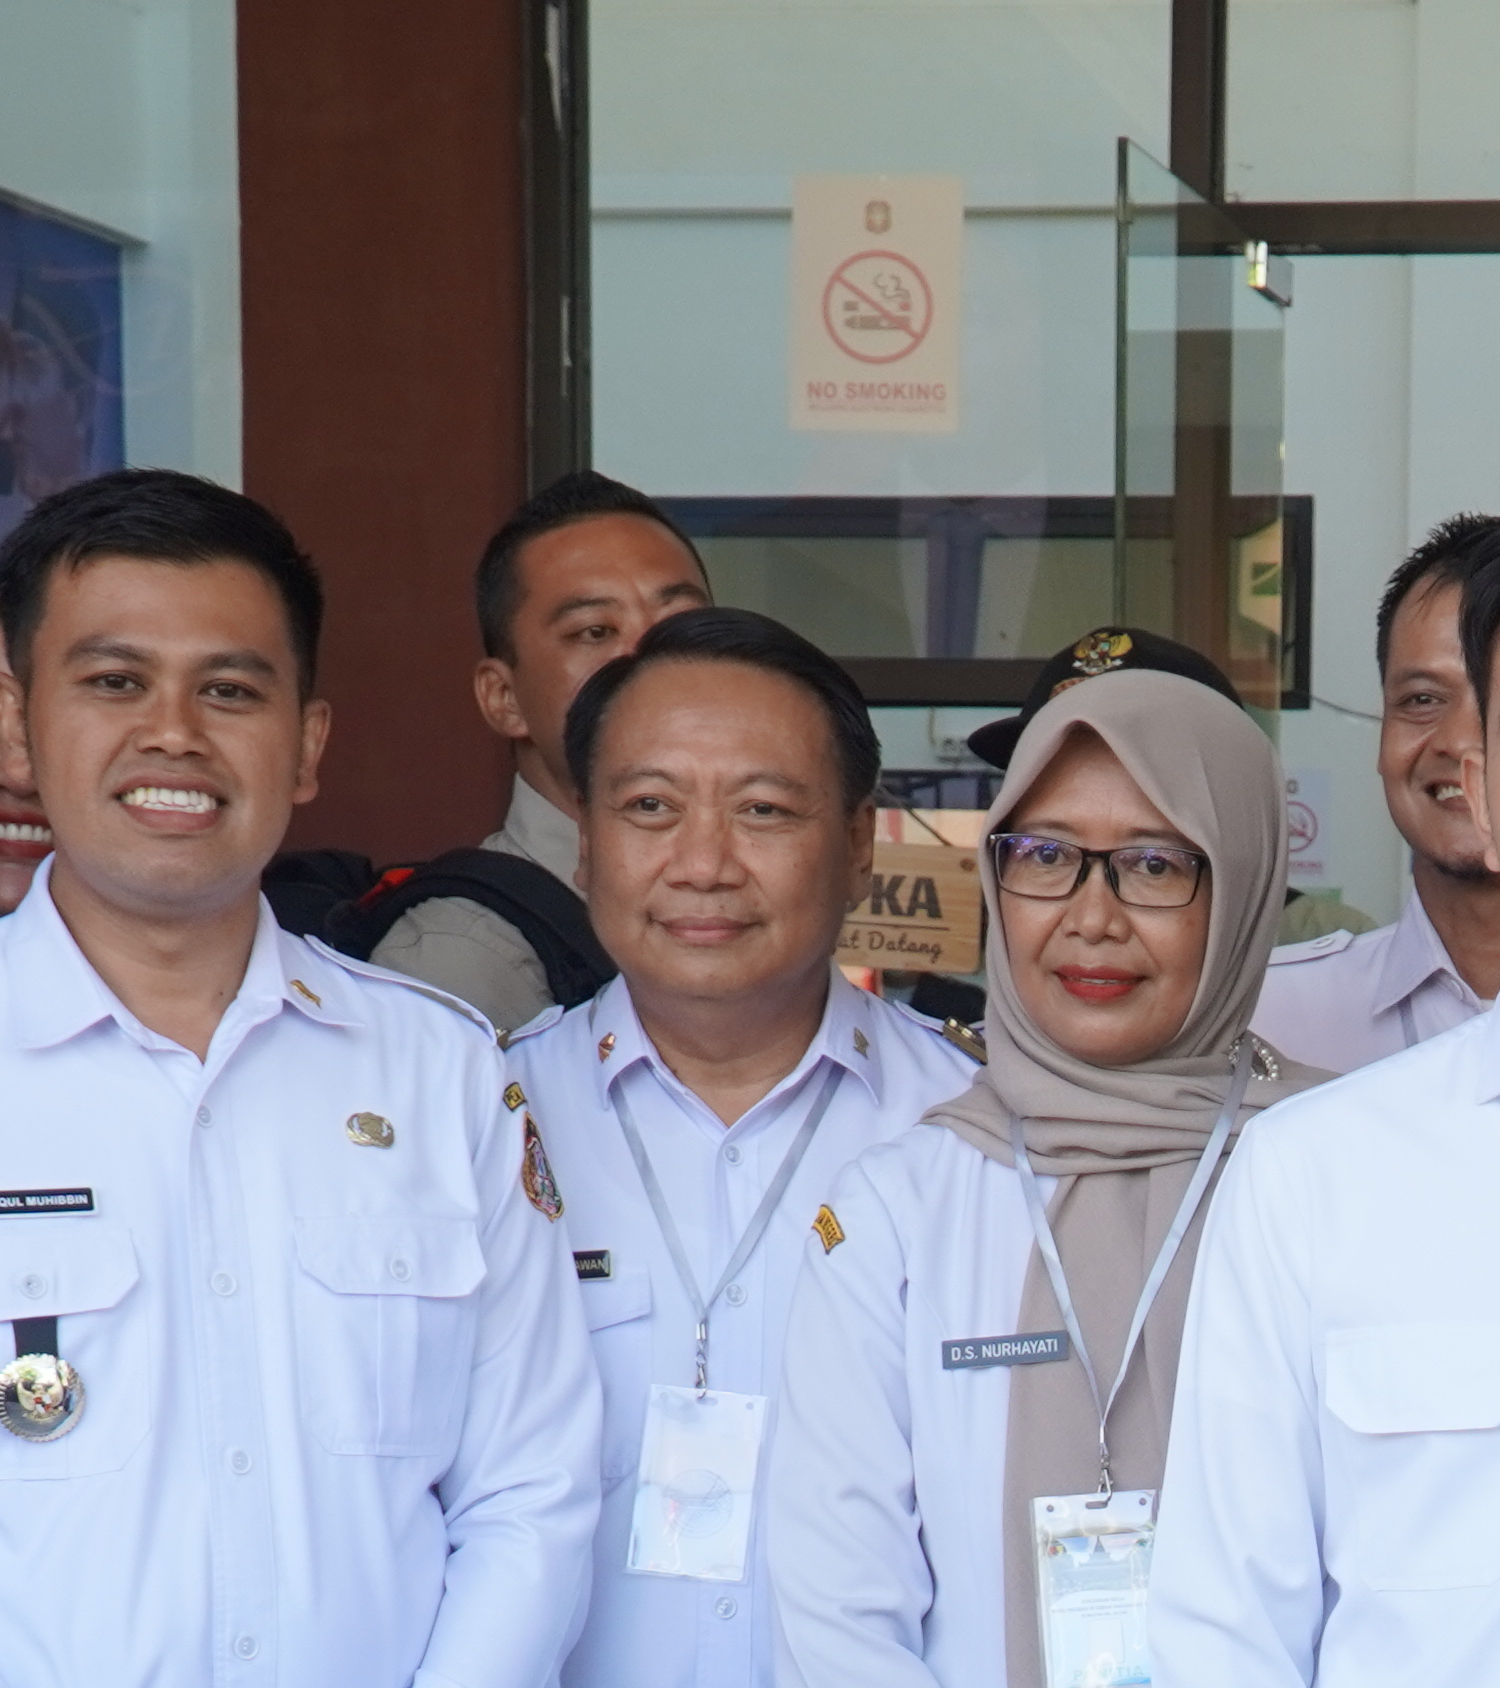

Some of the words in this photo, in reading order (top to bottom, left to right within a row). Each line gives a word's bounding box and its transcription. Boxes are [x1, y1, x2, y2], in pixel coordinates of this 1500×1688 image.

[806, 381, 838, 400] NO
[845, 381, 948, 401] SMOKING
[869, 873, 943, 919] KA
[867, 930, 943, 964] Datang
[26, 1193, 89, 1207] MUHIBBIN
[950, 1345, 979, 1361] D.S.
[981, 1338, 1058, 1359] NURHAYATI
[1073, 1665, 1144, 1682] PNITIA
